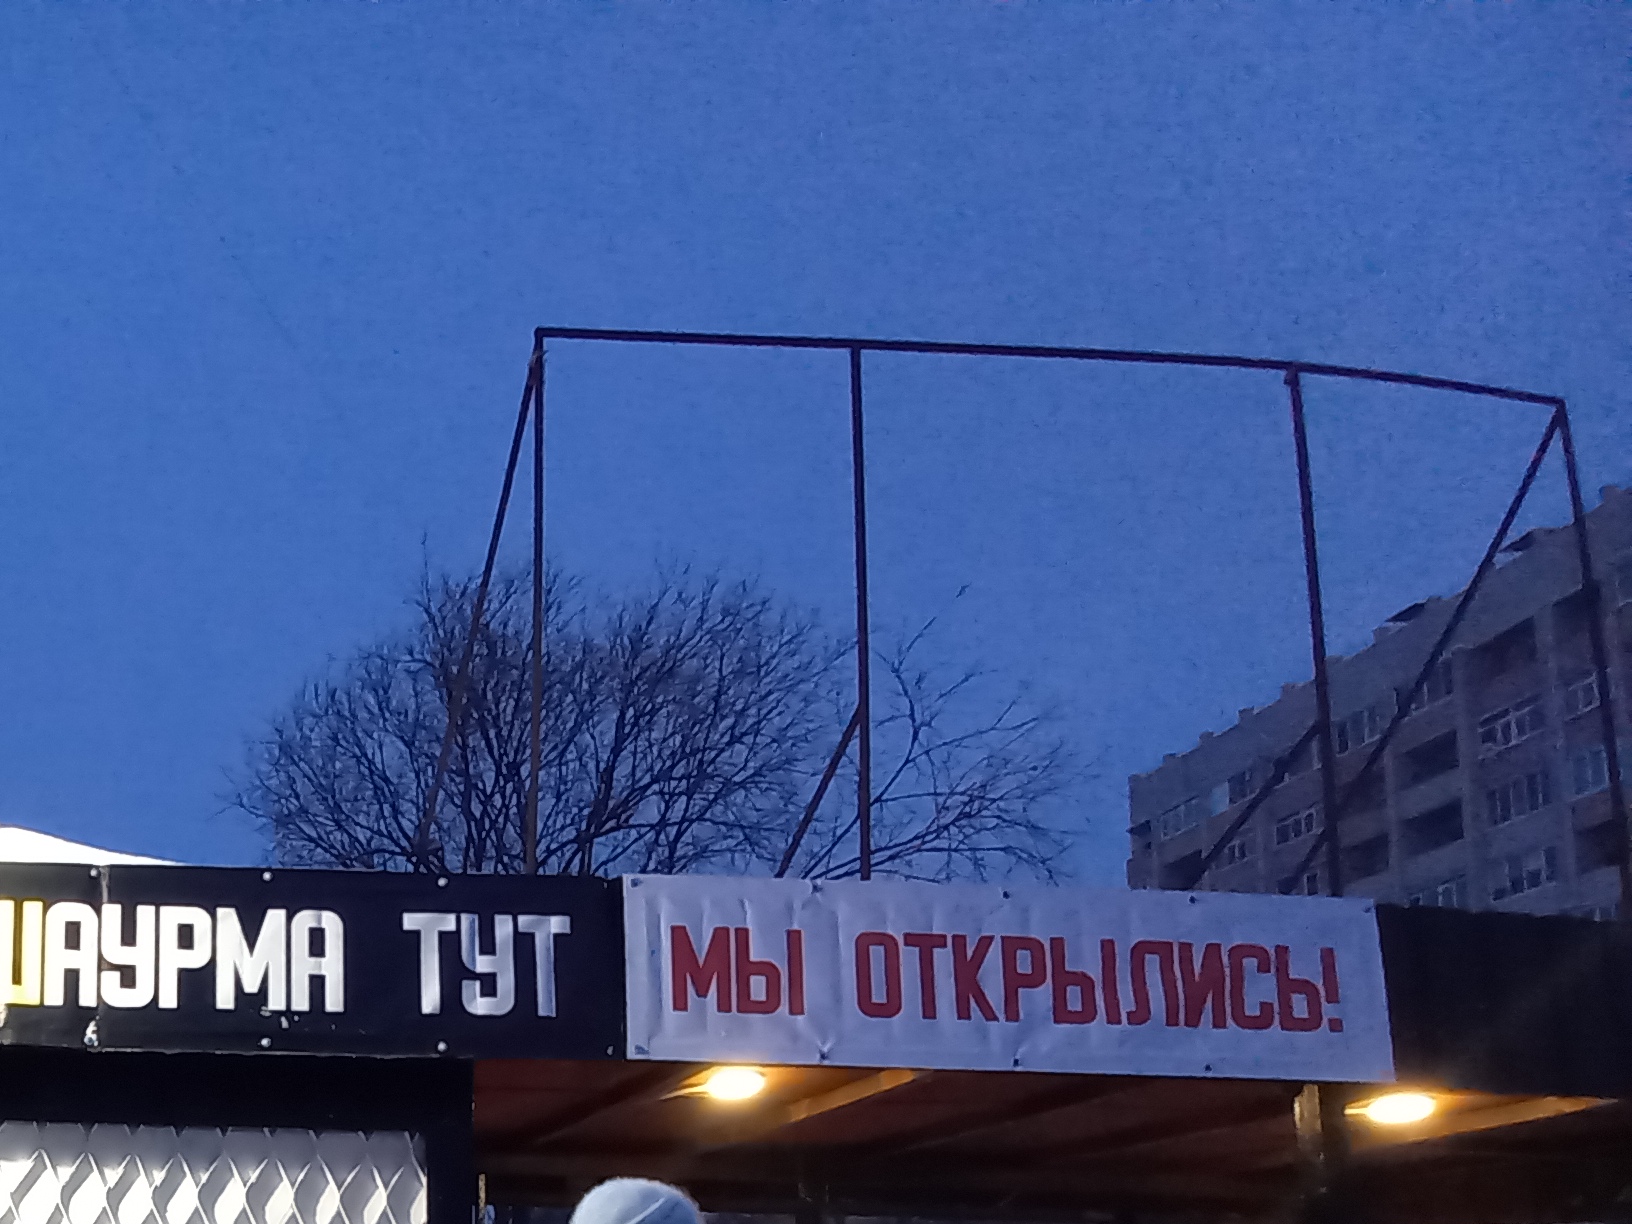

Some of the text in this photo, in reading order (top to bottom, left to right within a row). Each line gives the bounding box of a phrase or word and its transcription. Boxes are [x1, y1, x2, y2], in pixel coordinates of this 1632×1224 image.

[402, 912, 571, 1018] ТУТ
[669, 924, 1343, 1034] МЫ ОТКРЫЛИСЬ!
